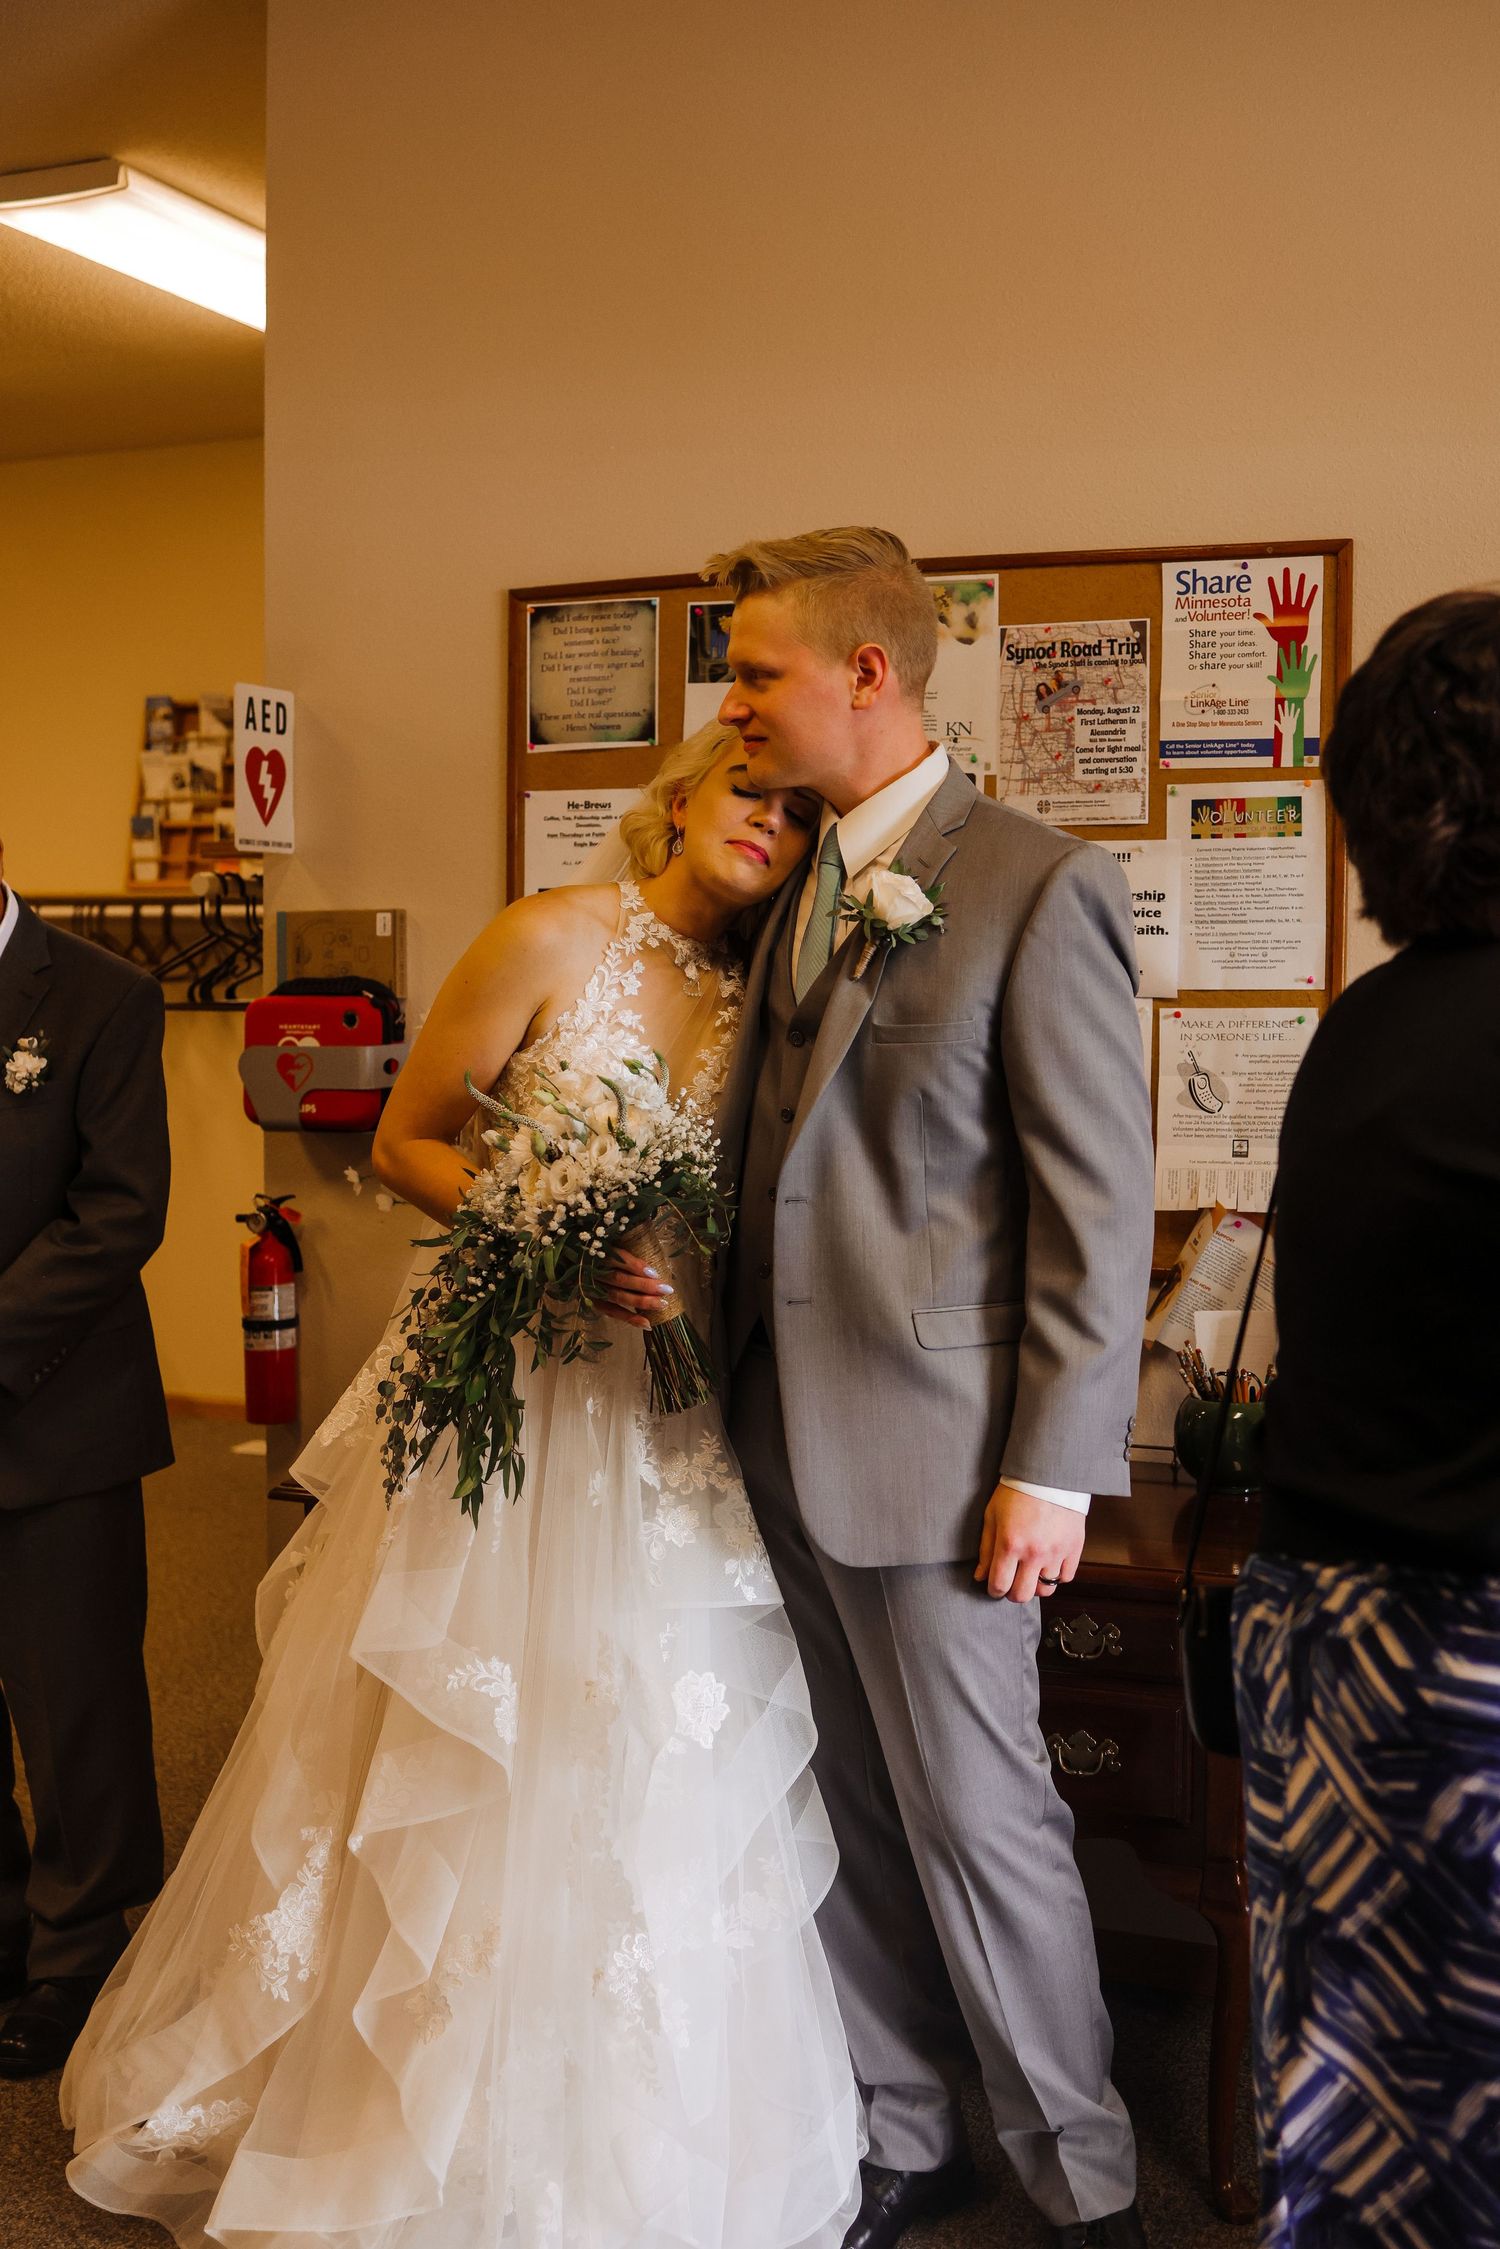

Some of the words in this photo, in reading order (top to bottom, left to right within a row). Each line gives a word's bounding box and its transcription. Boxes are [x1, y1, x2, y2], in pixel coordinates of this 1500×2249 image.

[1176, 569, 1252, 595] Share
[1175, 595, 1251, 610] Minnesota
[1188, 609, 1251, 622] Volunteer!
[1189, 629, 1216, 638] Share
[1220, 630, 1235, 638] your
[1189, 640, 1216, 649] Share
[1220, 641, 1235, 649] your
[1006, 642, 1057, 664] Synod
[1061, 639, 1101, 658] Road
[1107, 637, 1141, 659] Trip
[1189, 651, 1216, 659] Share
[1220, 652, 1235, 660] your
[630, 660, 644, 668] and
[1048, 661, 1069, 670] Synod
[1094, 659, 1119, 668] coming
[1199, 661, 1226, 670] share
[1228, 663, 1244, 671] your
[1246, 661, 1262, 669] skill!
[1190, 690, 1217, 699] Senior
[1190, 699, 1227, 709] LinkAge
[244, 696, 287, 735] AED
[1077, 708, 1105, 716] Monday,
[1107, 707, 1131, 715] August
[1090, 728, 1126, 736] Alexandria
[1095, 745, 1105, 753] for
[1107, 745, 1123, 754] light
[1092, 755, 1137, 763] conversation
[1082, 767, 1109, 775] starting
[567, 800, 611, 810] He-Brews
[1199, 809, 1297, 824] VOLUNTEER
[1132, 890, 1165, 902] rship
[1133, 907, 1162, 918] vice
[1134, 925, 1169, 935] aith.
[1180, 1020, 1214, 1029] MAKE
[1216, 1020, 1225, 1028] A
[1228, 1020, 1296, 1028] DIFFERENCE
[1180, 1033, 1193, 1041] IN
[1196, 1033, 1259, 1041] SOMEONE'S
